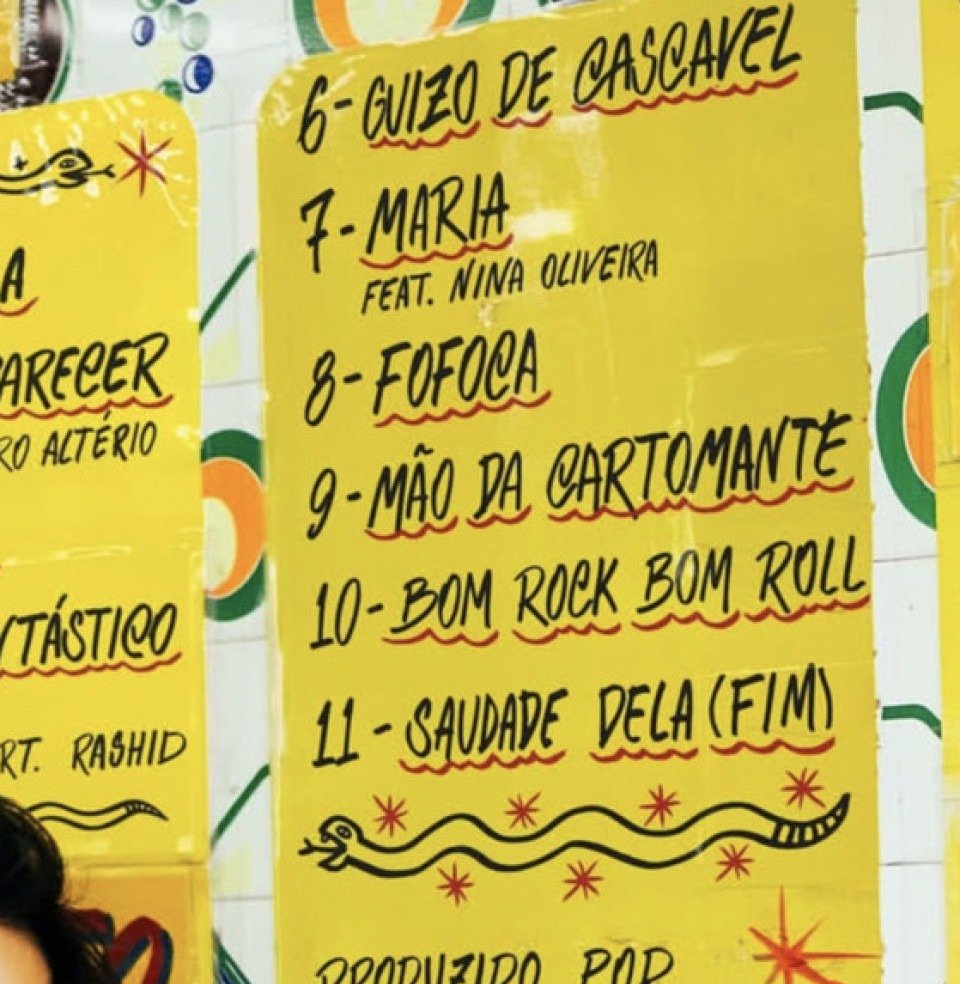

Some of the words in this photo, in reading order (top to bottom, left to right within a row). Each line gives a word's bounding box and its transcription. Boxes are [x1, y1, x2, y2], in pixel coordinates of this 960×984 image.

[362, 59, 479, 140] GUIZO
[496, 45, 558, 120] DE
[572, 4, 802, 106] CASCAVEL
[365, 171, 511, 256] MARIA
[360, 271, 434, 315] FEAT.
[448, 257, 525, 303] NINA
[539, 238, 659, 291] OLIVEIRA
[372, 328, 538, 416] FOFOCA
[41, 412, 158, 466] ALTÉRIO
[366, 443, 455, 533] MÃO
[472, 451, 524, 521] DA
[545, 408, 854, 520] CARTOMANTE
[389, 569, 493, 634] BOM
[514, 556, 620, 627] ROCK
[635, 546, 734, 615] BOM
[755, 535, 867, 615] ROLL
[71, 729, 189, 776] RASHID
[404, 687, 570, 763] SAUDADE
[597, 679, 694, 750] DELA
[707, 661, 834, 739] (FIM)
